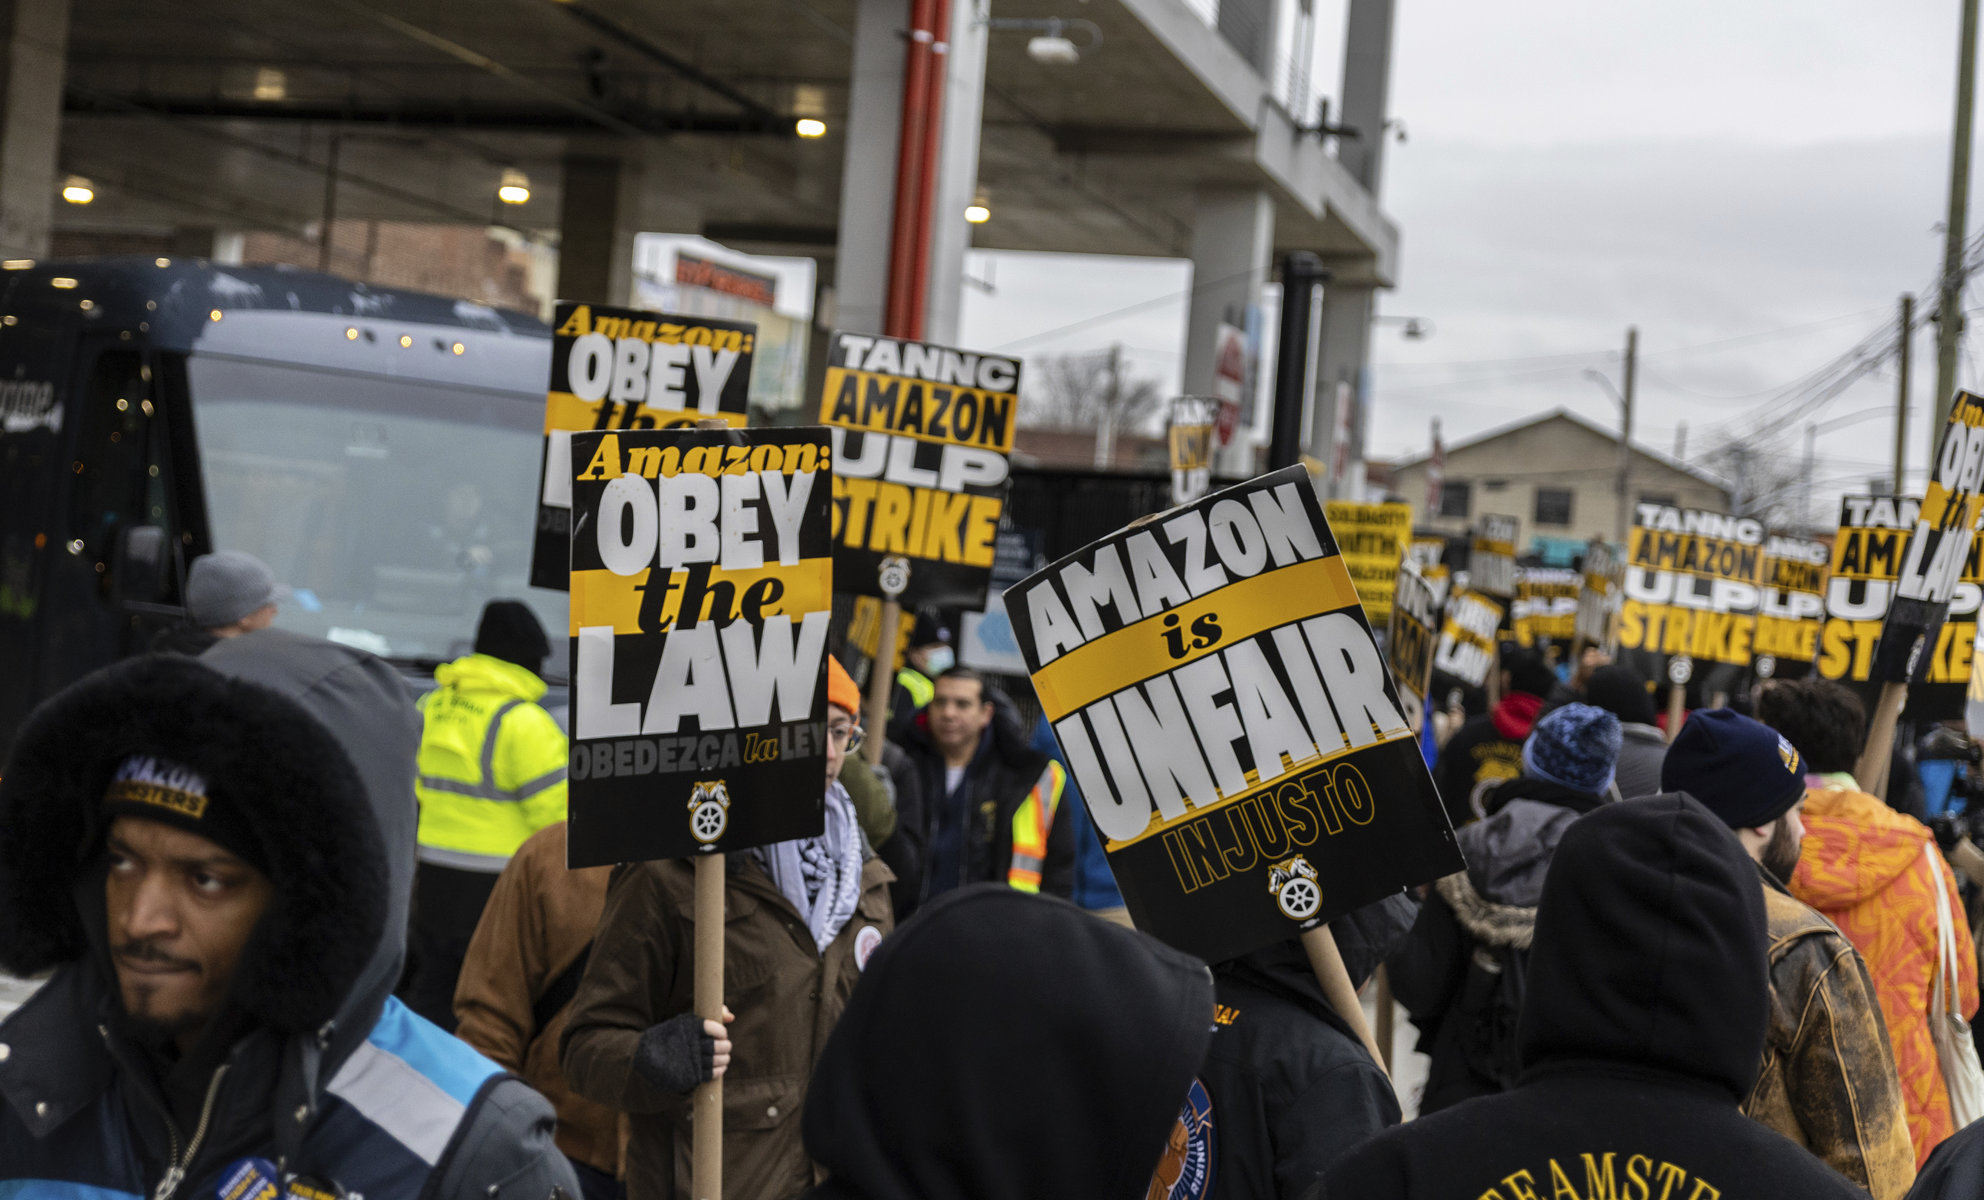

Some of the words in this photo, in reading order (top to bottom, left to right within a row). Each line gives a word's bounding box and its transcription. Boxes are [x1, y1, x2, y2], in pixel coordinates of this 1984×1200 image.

[556, 305, 754, 352] Amazon:
[567, 331, 741, 415] OBEY
[839, 334, 1017, 392] TANNC
[831, 374, 1010, 447] AMAZON
[576, 434, 830, 479] Amazon:
[831, 427, 1009, 493] ULP
[597, 468, 817, 577] OBEY
[1637, 503, 1763, 545] TANNC
[1026, 482, 1324, 668] AMAZON
[1624, 565, 1759, 613] ULP
[1635, 533, 1758, 582] AMAZON
[634, 562, 785, 633] the
[1161, 612, 1223, 660] is
[1620, 598, 1750, 666] STRIKE
[576, 610, 831, 740] LAW
[570, 733, 741, 781] OBEDEZCA
[744, 733, 779, 763] la
[780, 723, 829, 762] LEY
[1055, 612, 1412, 842] UNFAIR
[1162, 762, 1375, 894] INJUSTO
